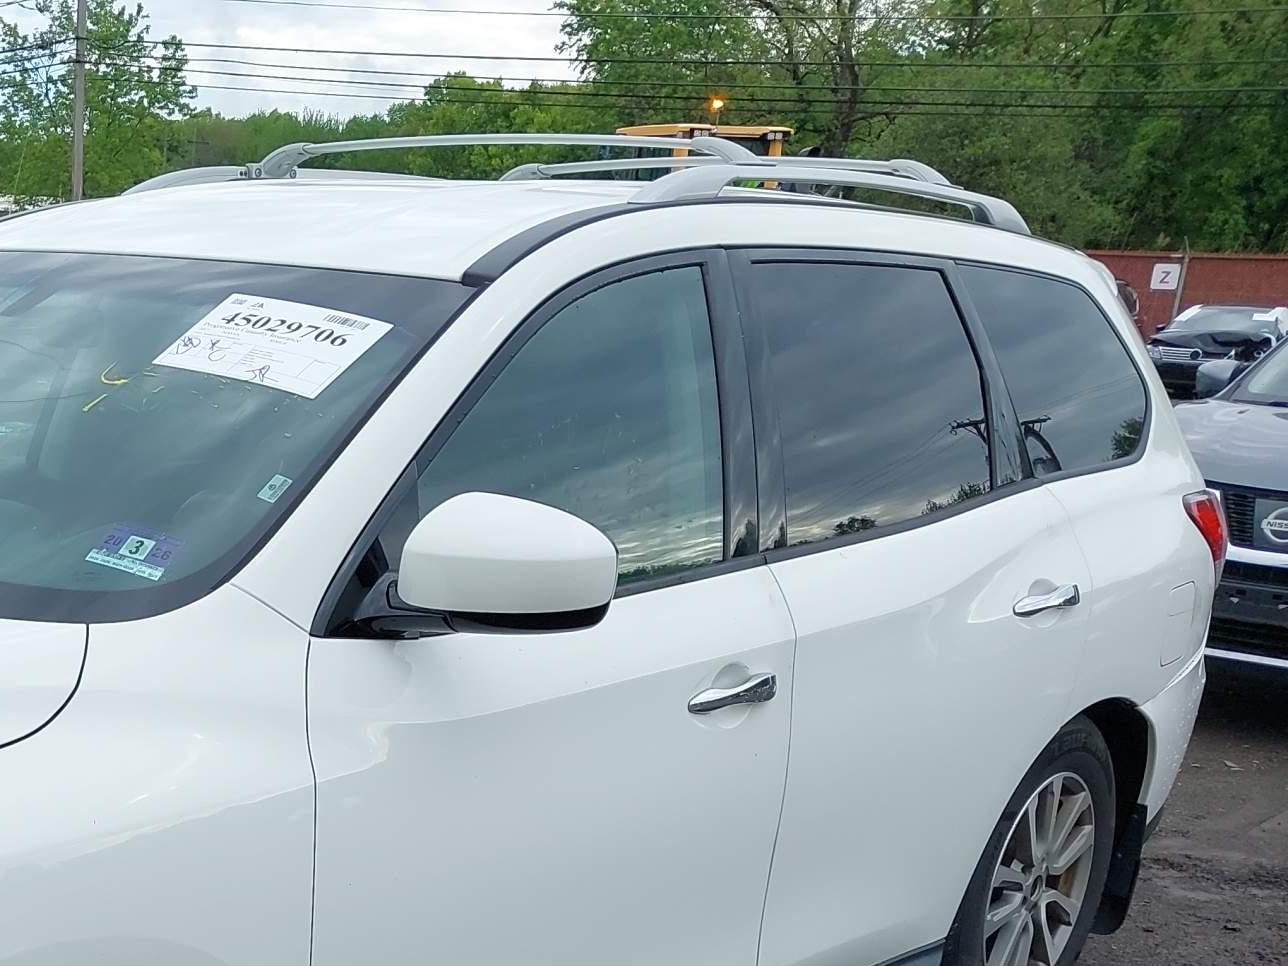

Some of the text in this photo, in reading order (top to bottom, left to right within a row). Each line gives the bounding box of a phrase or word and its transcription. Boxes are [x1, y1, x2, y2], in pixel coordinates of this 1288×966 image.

[1159, 270, 1172, 284] Z
[221, 311, 355, 347] 45029706
[128, 540, 145, 555] 3
[152, 547, 172, 561] 26
